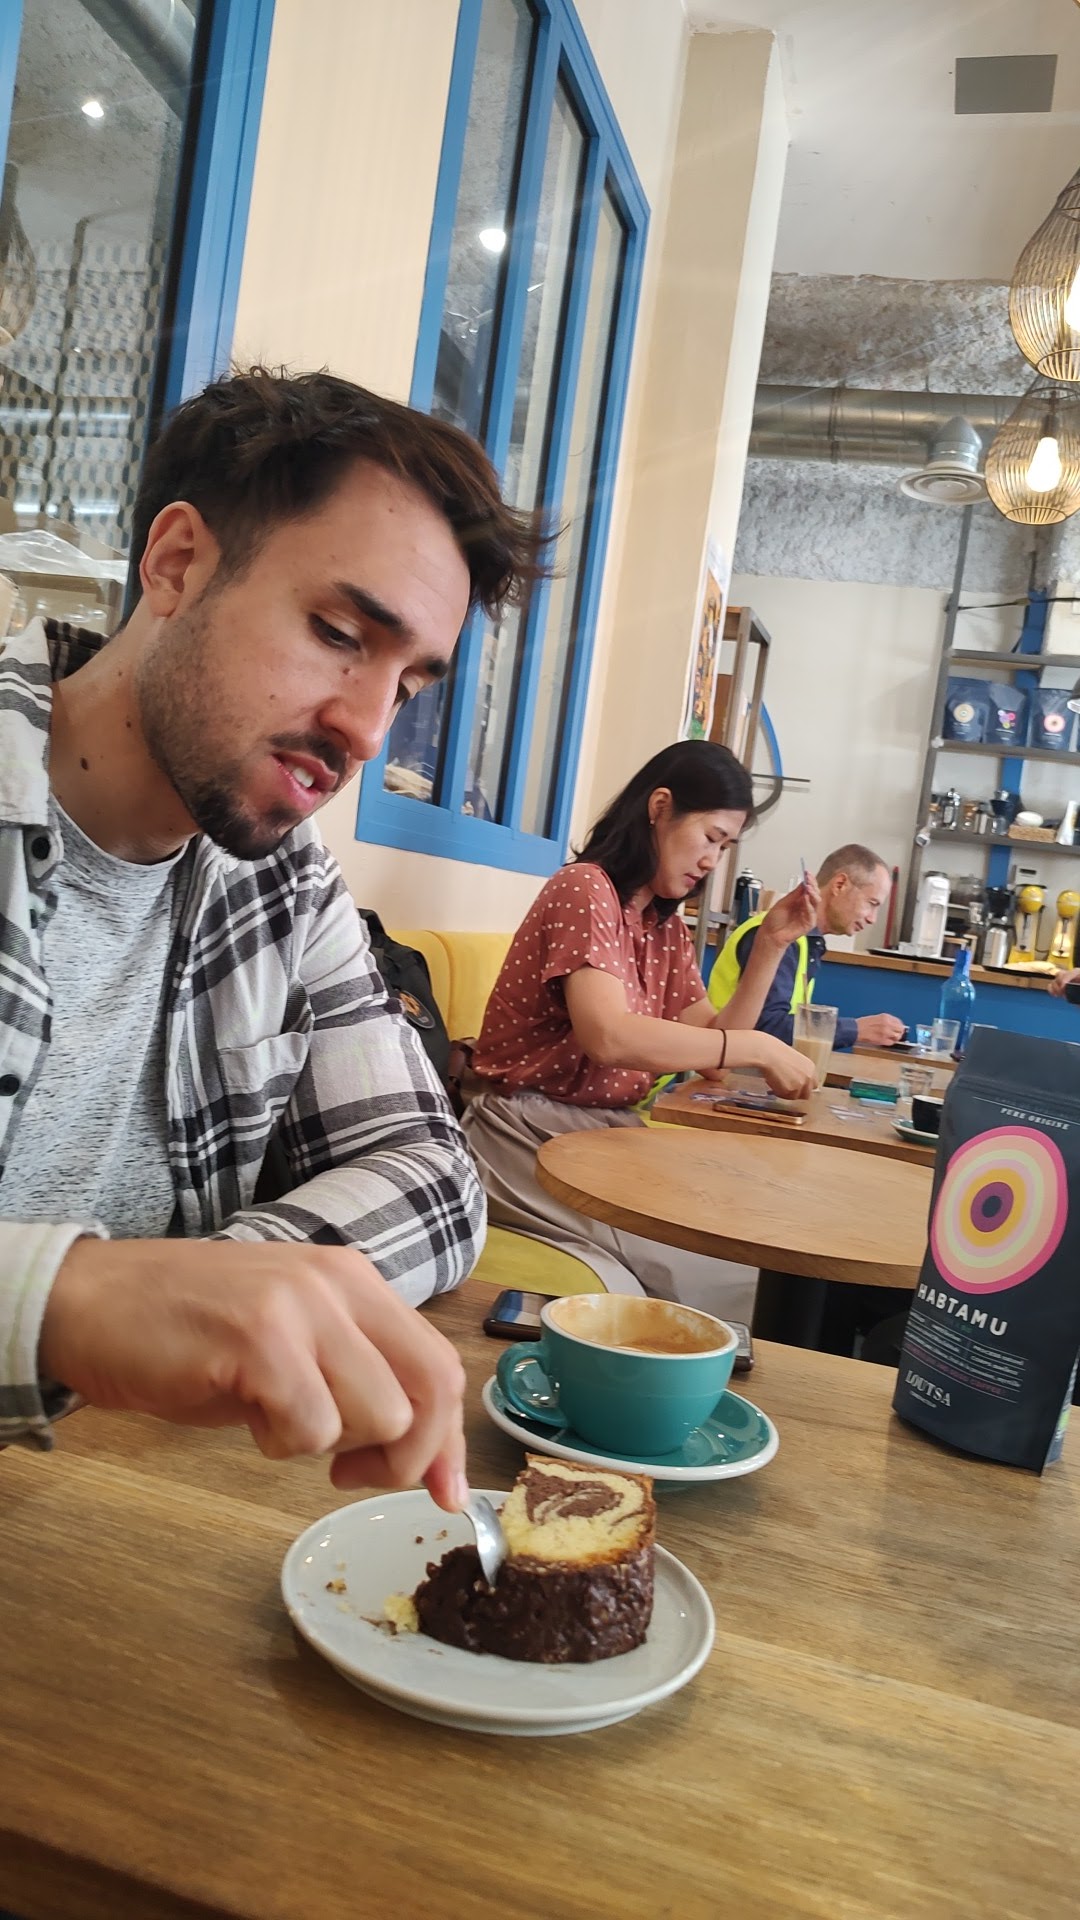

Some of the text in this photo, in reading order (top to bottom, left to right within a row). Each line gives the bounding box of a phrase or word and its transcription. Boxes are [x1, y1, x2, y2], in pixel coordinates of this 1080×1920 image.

[1000, 1107, 1071, 1131] PURE ORIGINE
[917, 1283, 1008, 1337] HABTAMU
[904, 1370, 951, 1407] LOUTSA
